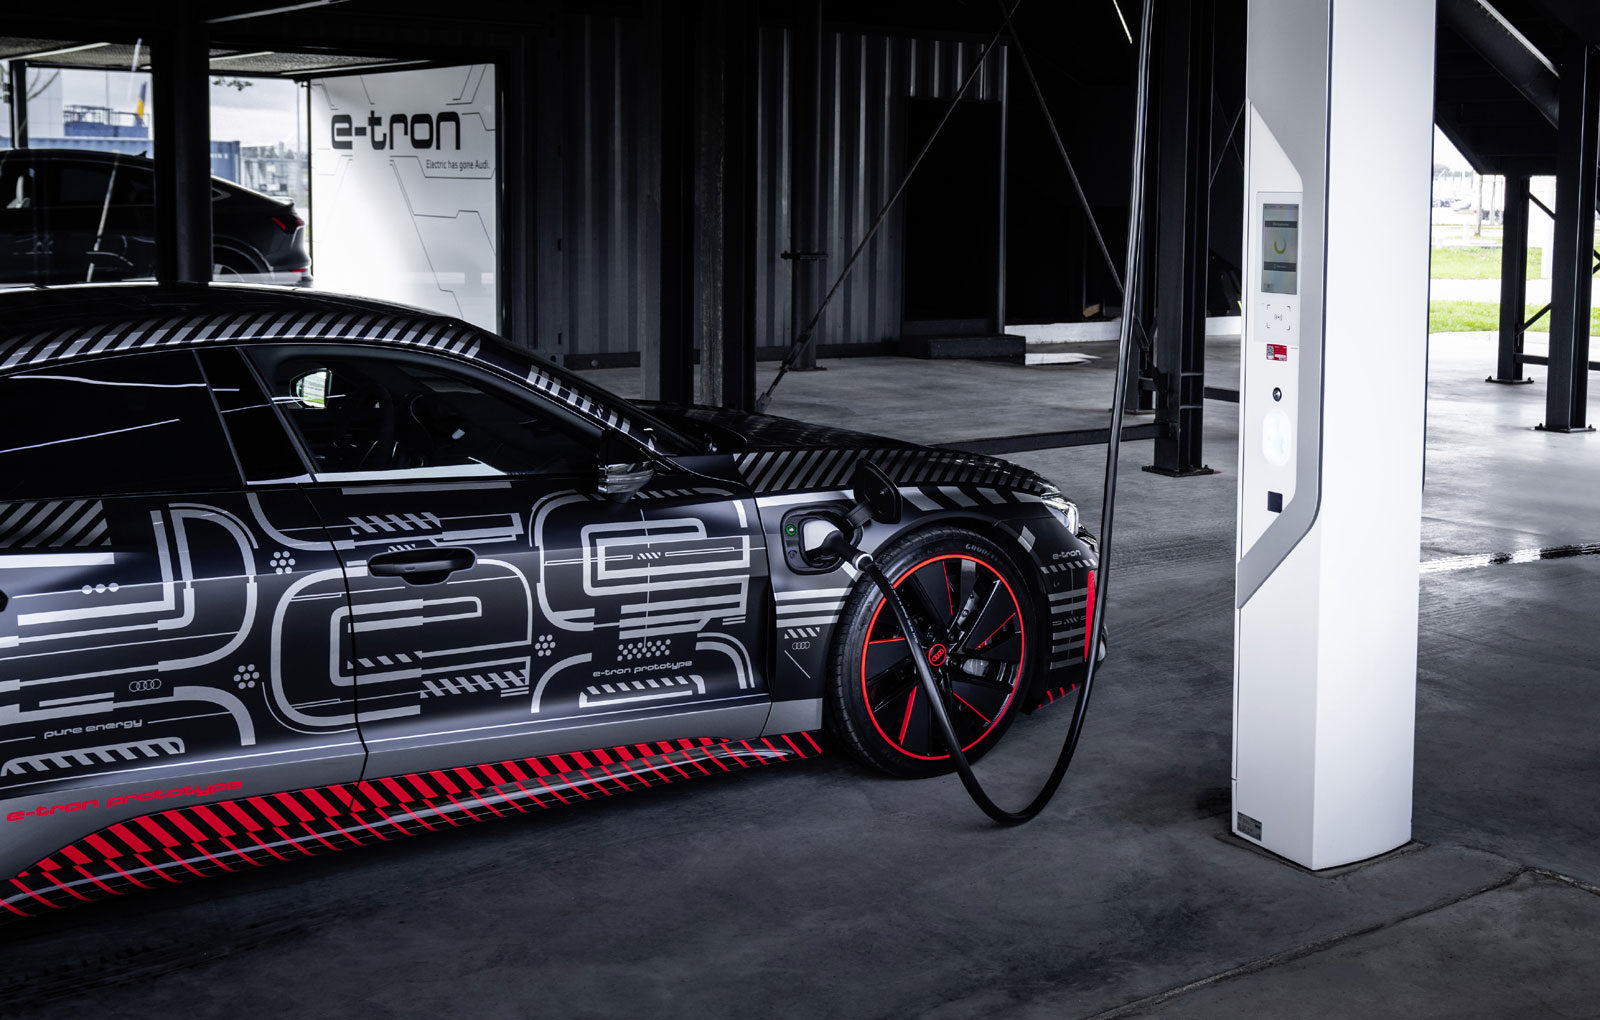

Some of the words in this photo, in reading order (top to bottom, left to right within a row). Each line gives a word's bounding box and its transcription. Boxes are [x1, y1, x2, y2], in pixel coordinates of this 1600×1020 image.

[331, 110, 461, 150] e-tron
[426, 159, 447, 169] Electric
[448, 160, 458, 169] has
[459, 161, 474, 172] gone
[475, 159, 491, 169] Audi.
[1052, 549, 1082, 560] e-tron
[592, 667, 632, 677] e-tron
[633, 660, 693, 674] prototype
[44, 726, 83, 739] pure
[85, 719, 143, 733] energy
[6, 799, 99, 822] e-tron
[106, 780, 243, 809] prototype
